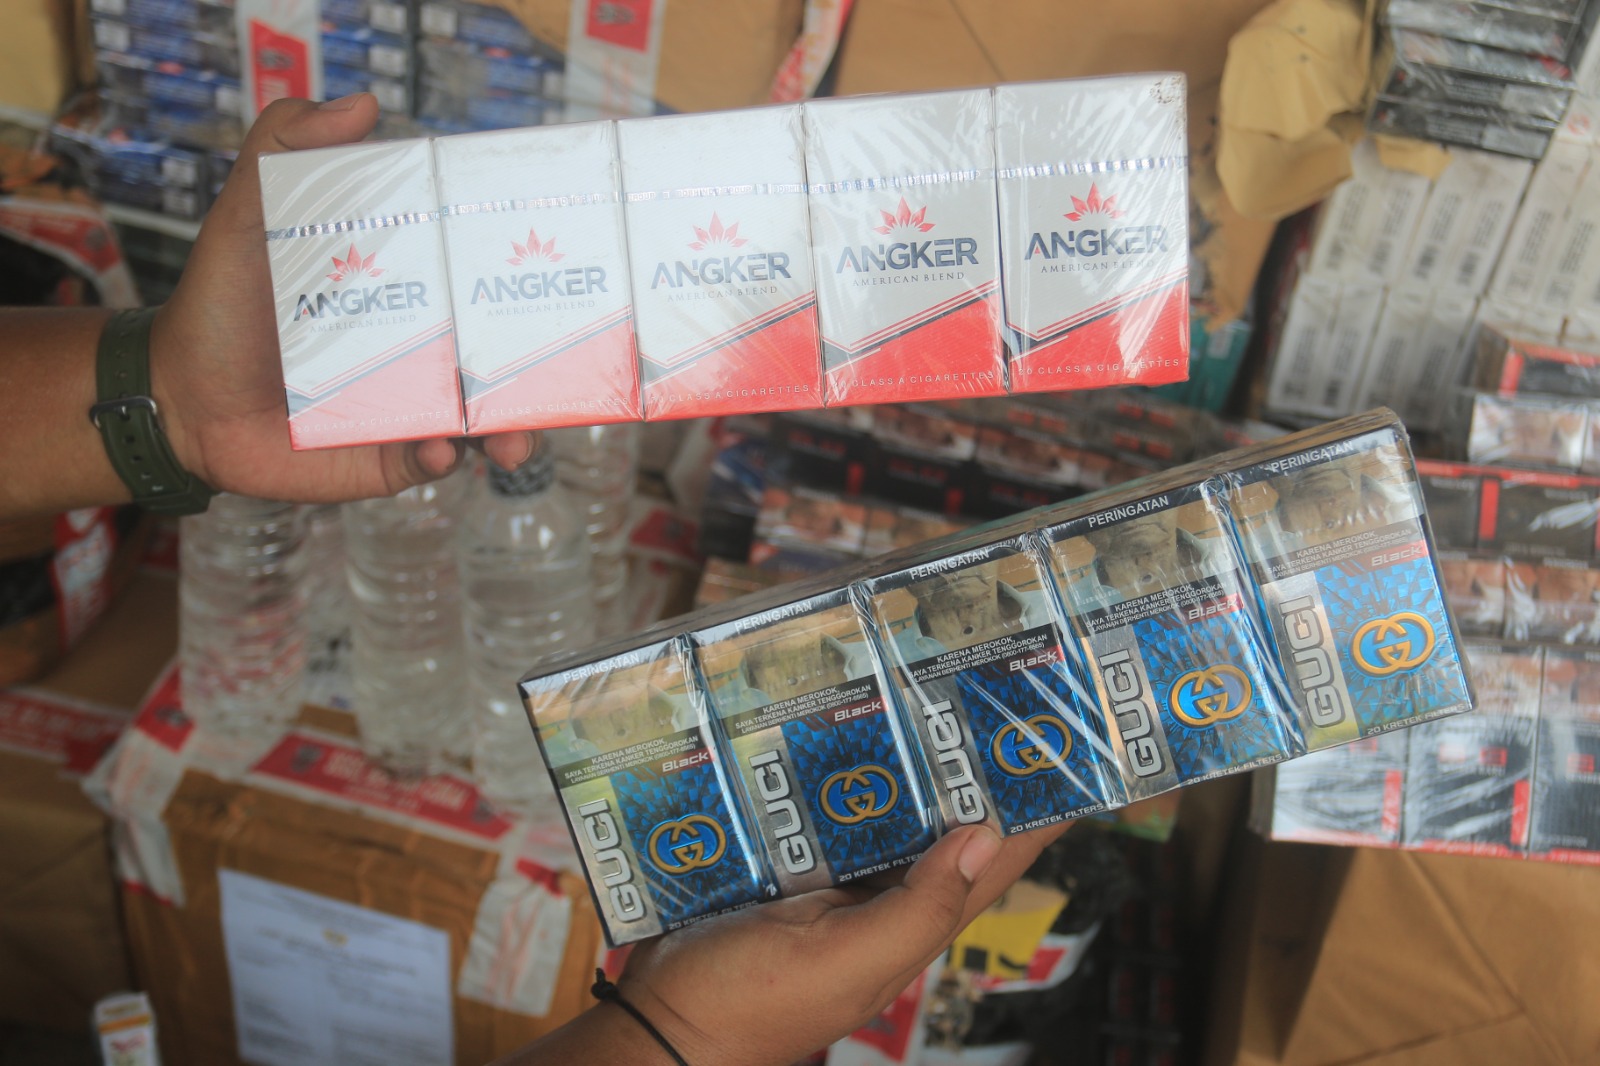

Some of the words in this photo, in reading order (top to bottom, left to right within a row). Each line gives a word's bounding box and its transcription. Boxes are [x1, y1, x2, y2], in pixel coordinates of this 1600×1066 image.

[835, 236, 980, 274] ANGKER
[1023, 223, 1169, 261] ANGKER
[650, 251, 791, 290] ANGKER
[852, 274, 918, 287] AMERICAN
[924, 269, 964, 282] BLEND
[1040, 260, 1107, 275] AMERICAN
[470, 266, 609, 305] ANGKER
[667, 288, 732, 303] AMERICAN
[737, 283, 777, 298] BLEND
[293, 280, 429, 322] ANGKER
[487, 303, 551, 318] AMERICAN
[556, 298, 595, 312] BLEND
[310, 318, 377, 333] AMERICAN
[382, 313, 416, 325] BLEND
[853, 376, 892, 387] CLASS
[910, 372, 993, 383] CIGARETTES
[1038, 365, 1080, 375] CLASS
[669, 392, 709, 402] CLASS
[726, 385, 808, 397] CIGARETTES
[490, 405, 533, 417] CLASS
[314, 420, 356, 432] CLASS
[1271, 440, 1354, 472] PERINGATAN
[1088, 495, 1169, 528] PERINGATAN
[910, 549, 990, 580] PERINGATAN
[1296, 543, 1331, 558] KARENA
[1321, 545, 1352, 558] KANKER
[1371, 544, 1423, 567] Black
[734, 600, 812, 633] PERINGATAN
[1104, 607, 1139, 622] TERKENA
[1139, 598, 1169, 611] KANKER
[1114, 598, 1147, 611] KARENA
[1188, 599, 1239, 620] Black
[1092, 620, 1120, 632] LAYANAN
[926, 658, 961, 673] TERKENA
[960, 650, 991, 663] KANKER
[990, 633, 1048, 654] TENGGOROKAN
[936, 648, 971, 663] KARENA
[971, 635, 1015, 653] MEROKOK,
[1009, 651, 1058, 672] Black
[1279, 595, 1344, 728] GUCI
[563, 653, 640, 684] PERINGATAN
[914, 671, 941, 682] LAYANAN
[941, 662, 971, 674] BERHENTI
[971, 653, 1001, 666] MEROKOK
[735, 719, 754, 729] SAYA
[754, 709, 787, 723] TERKENA
[786, 700, 816, 713] KANKER
[816, 684, 871, 704] TENGGOROKAN
[762, 699, 796, 713] KARENA
[796, 686, 839, 703] MEROKOK,
[834, 701, 882, 723] Black
[1099, 649, 1163, 777] GUCI
[741, 722, 768, 733] LAYANAN
[767, 713, 797, 725] BERHENTI
[796, 704, 826, 716] MEROKOK
[1367, 726, 1381, 735] 20
[1383, 715, 1422, 731] KRETEK
[1424, 703, 1466, 720] FILTERS
[564, 769, 583, 779] SAYA
[583, 759, 615, 773] TERKENA
[615, 751, 646, 764] KANKER
[645, 735, 698, 755] TENGGOROKAN
[591, 750, 624, 764] KARENA
[626, 737, 666, 754] MEROKOK,
[662, 750, 709, 773] Black
[922, 700, 985, 824] GUCI
[570, 772, 596, 783] LAYANAN
[625, 755, 654, 767] MEROKOK
[1186, 776, 1201, 786] 20
[1202, 765, 1241, 781] KRETEK
[1243, 753, 1283, 770] FILTERS
[749, 750, 815, 875] GUCI
[1010, 824, 1024, 834] 20
[1025, 814, 1063, 829] KRETEK
[1065, 802, 1104, 819] FILTERS
[578, 798, 645, 922] GUCI
[839, 873, 852, 882] 20
[853, 862, 891, 878] KRETEK
